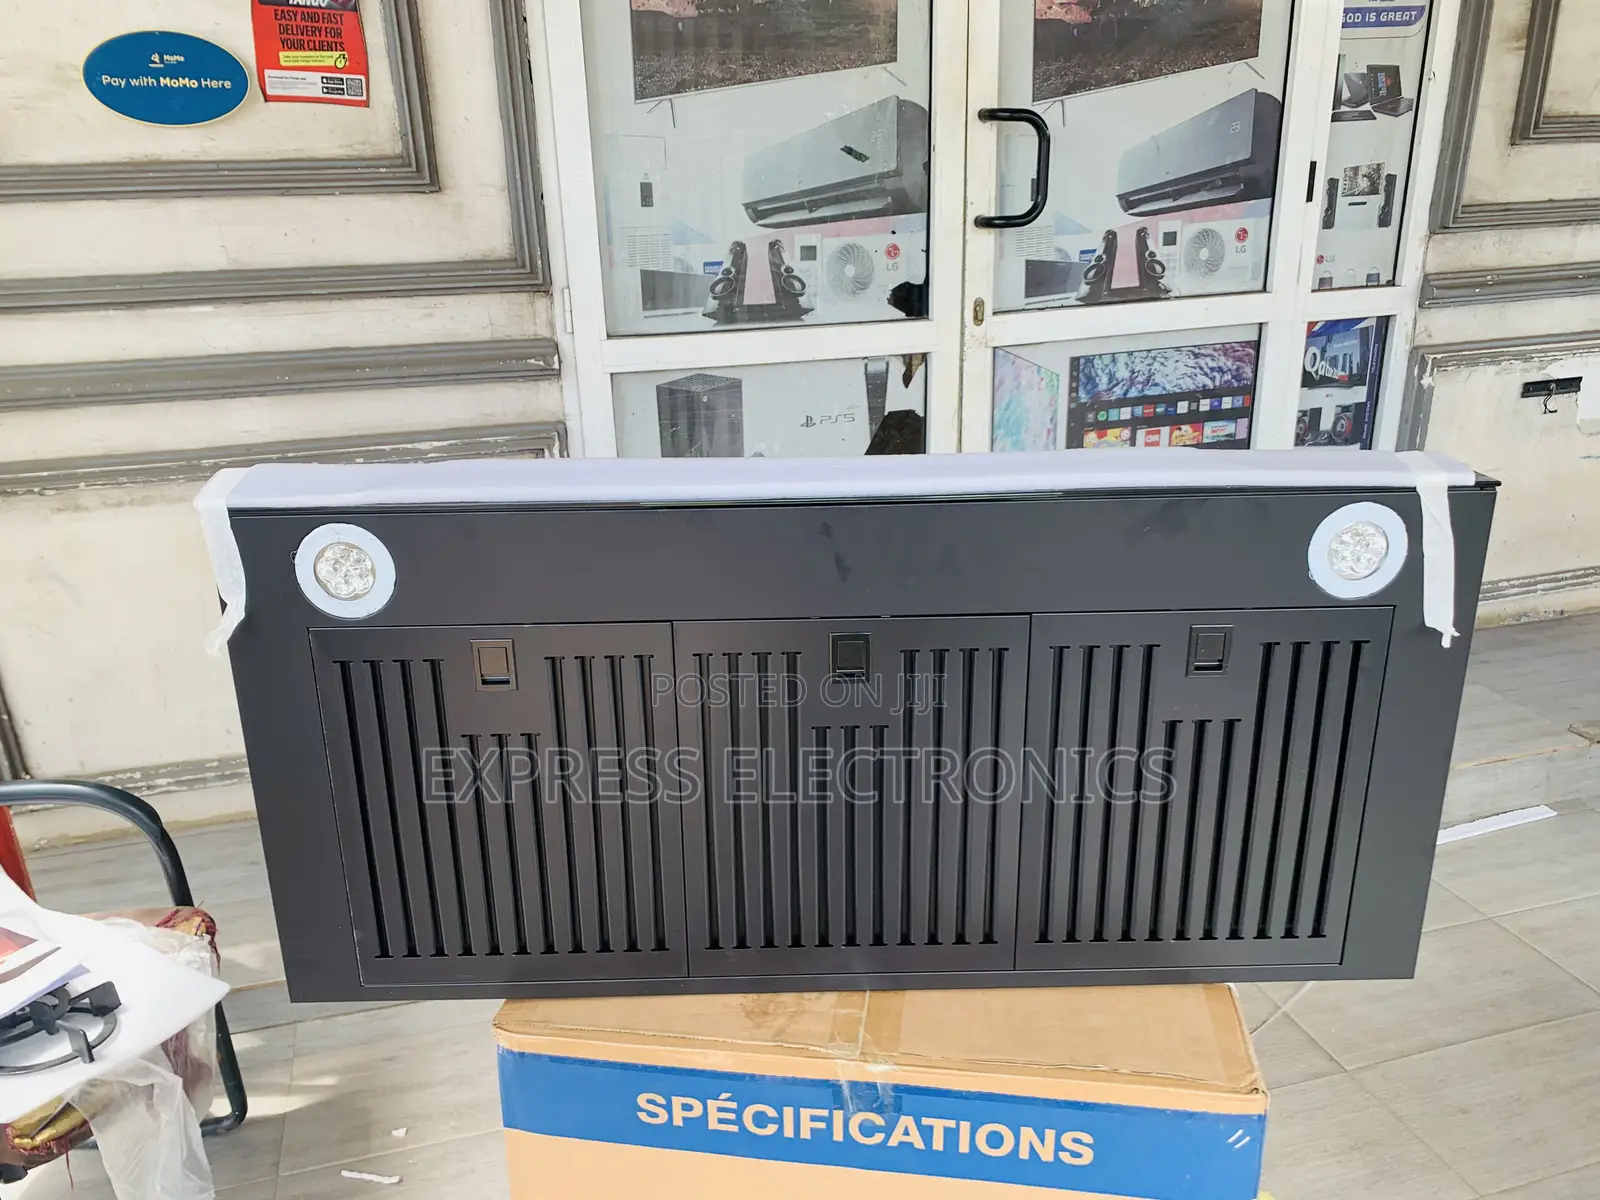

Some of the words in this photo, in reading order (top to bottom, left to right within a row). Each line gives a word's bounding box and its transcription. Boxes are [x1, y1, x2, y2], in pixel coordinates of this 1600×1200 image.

[274, 9, 298, 22] EASY
[300, 11, 320, 23] AND
[322, 13, 344, 25] FAST
[1366, 12, 1376, 22] IS
[1380, 11, 1417, 21] GREAT
[279, 24, 323, 37] DELIVERY
[325, 27, 342, 39] FOR
[280, 37, 305, 50] YOUR
[307, 39, 345, 52] CLIENTS
[101, 75, 126, 88] Pay
[129, 76, 157, 87] with
[160, 77, 198, 88] MoMo
[201, 78, 231, 89] Here
[1236, 245, 1247, 254] LG
[886, 262, 899, 271] LG
[820, 413, 855, 424] PS5
[636, 1093, 1095, 1166] SPÉCIFICATIONS
